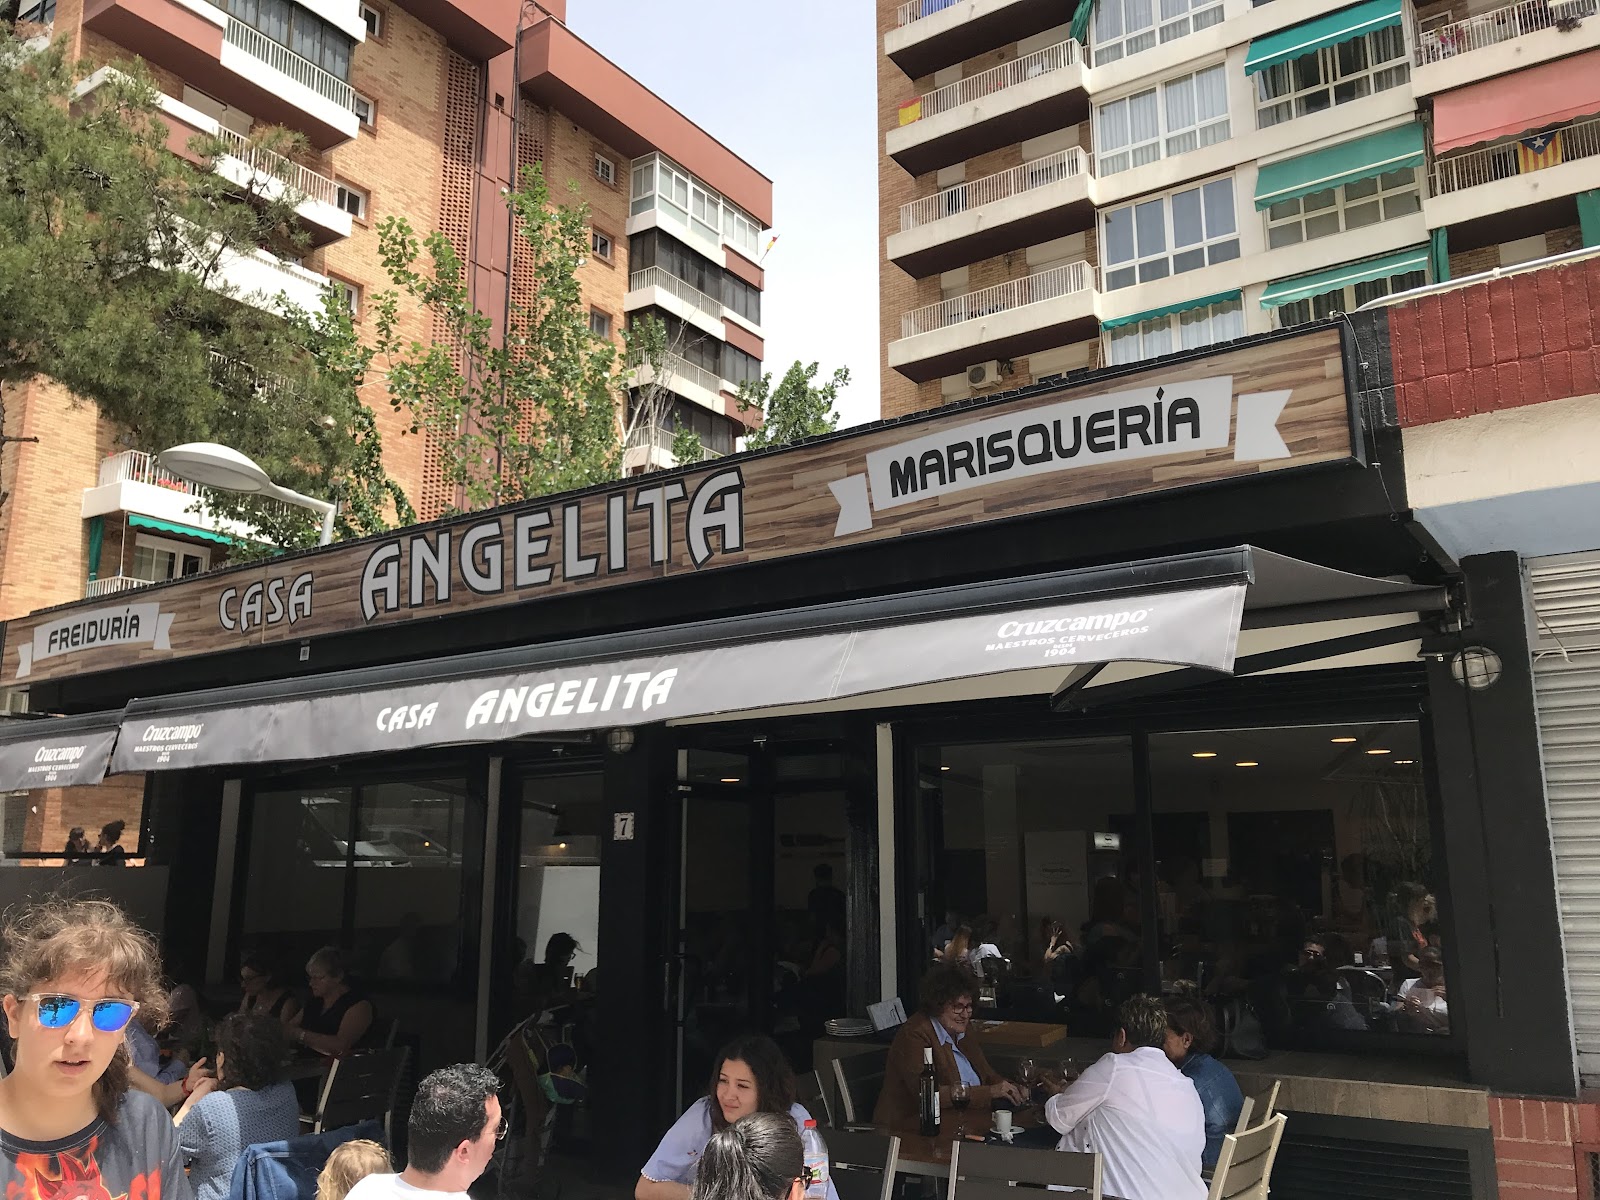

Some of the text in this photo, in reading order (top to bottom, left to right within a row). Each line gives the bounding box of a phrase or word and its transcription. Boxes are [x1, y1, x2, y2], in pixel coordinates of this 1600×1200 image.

[889, 386, 1201, 498] MARISQUERÍA
[218, 465, 746, 634] CASA ANGELITA
[48, 607, 140, 654] FREIDURÍA
[996, 609, 1149, 639] Cruzcampo
[984, 625, 1150, 652] MAESTROS CERVECEROS
[1043, 647, 1077, 658] 1904
[376, 667, 679, 734] CASA ANGELITA
[142, 724, 203, 743] Cruzcampo
[34, 745, 86, 763] Cruzcampo
[133, 745, 164, 753] MAESTROS
[620, 817, 629, 836] 7
